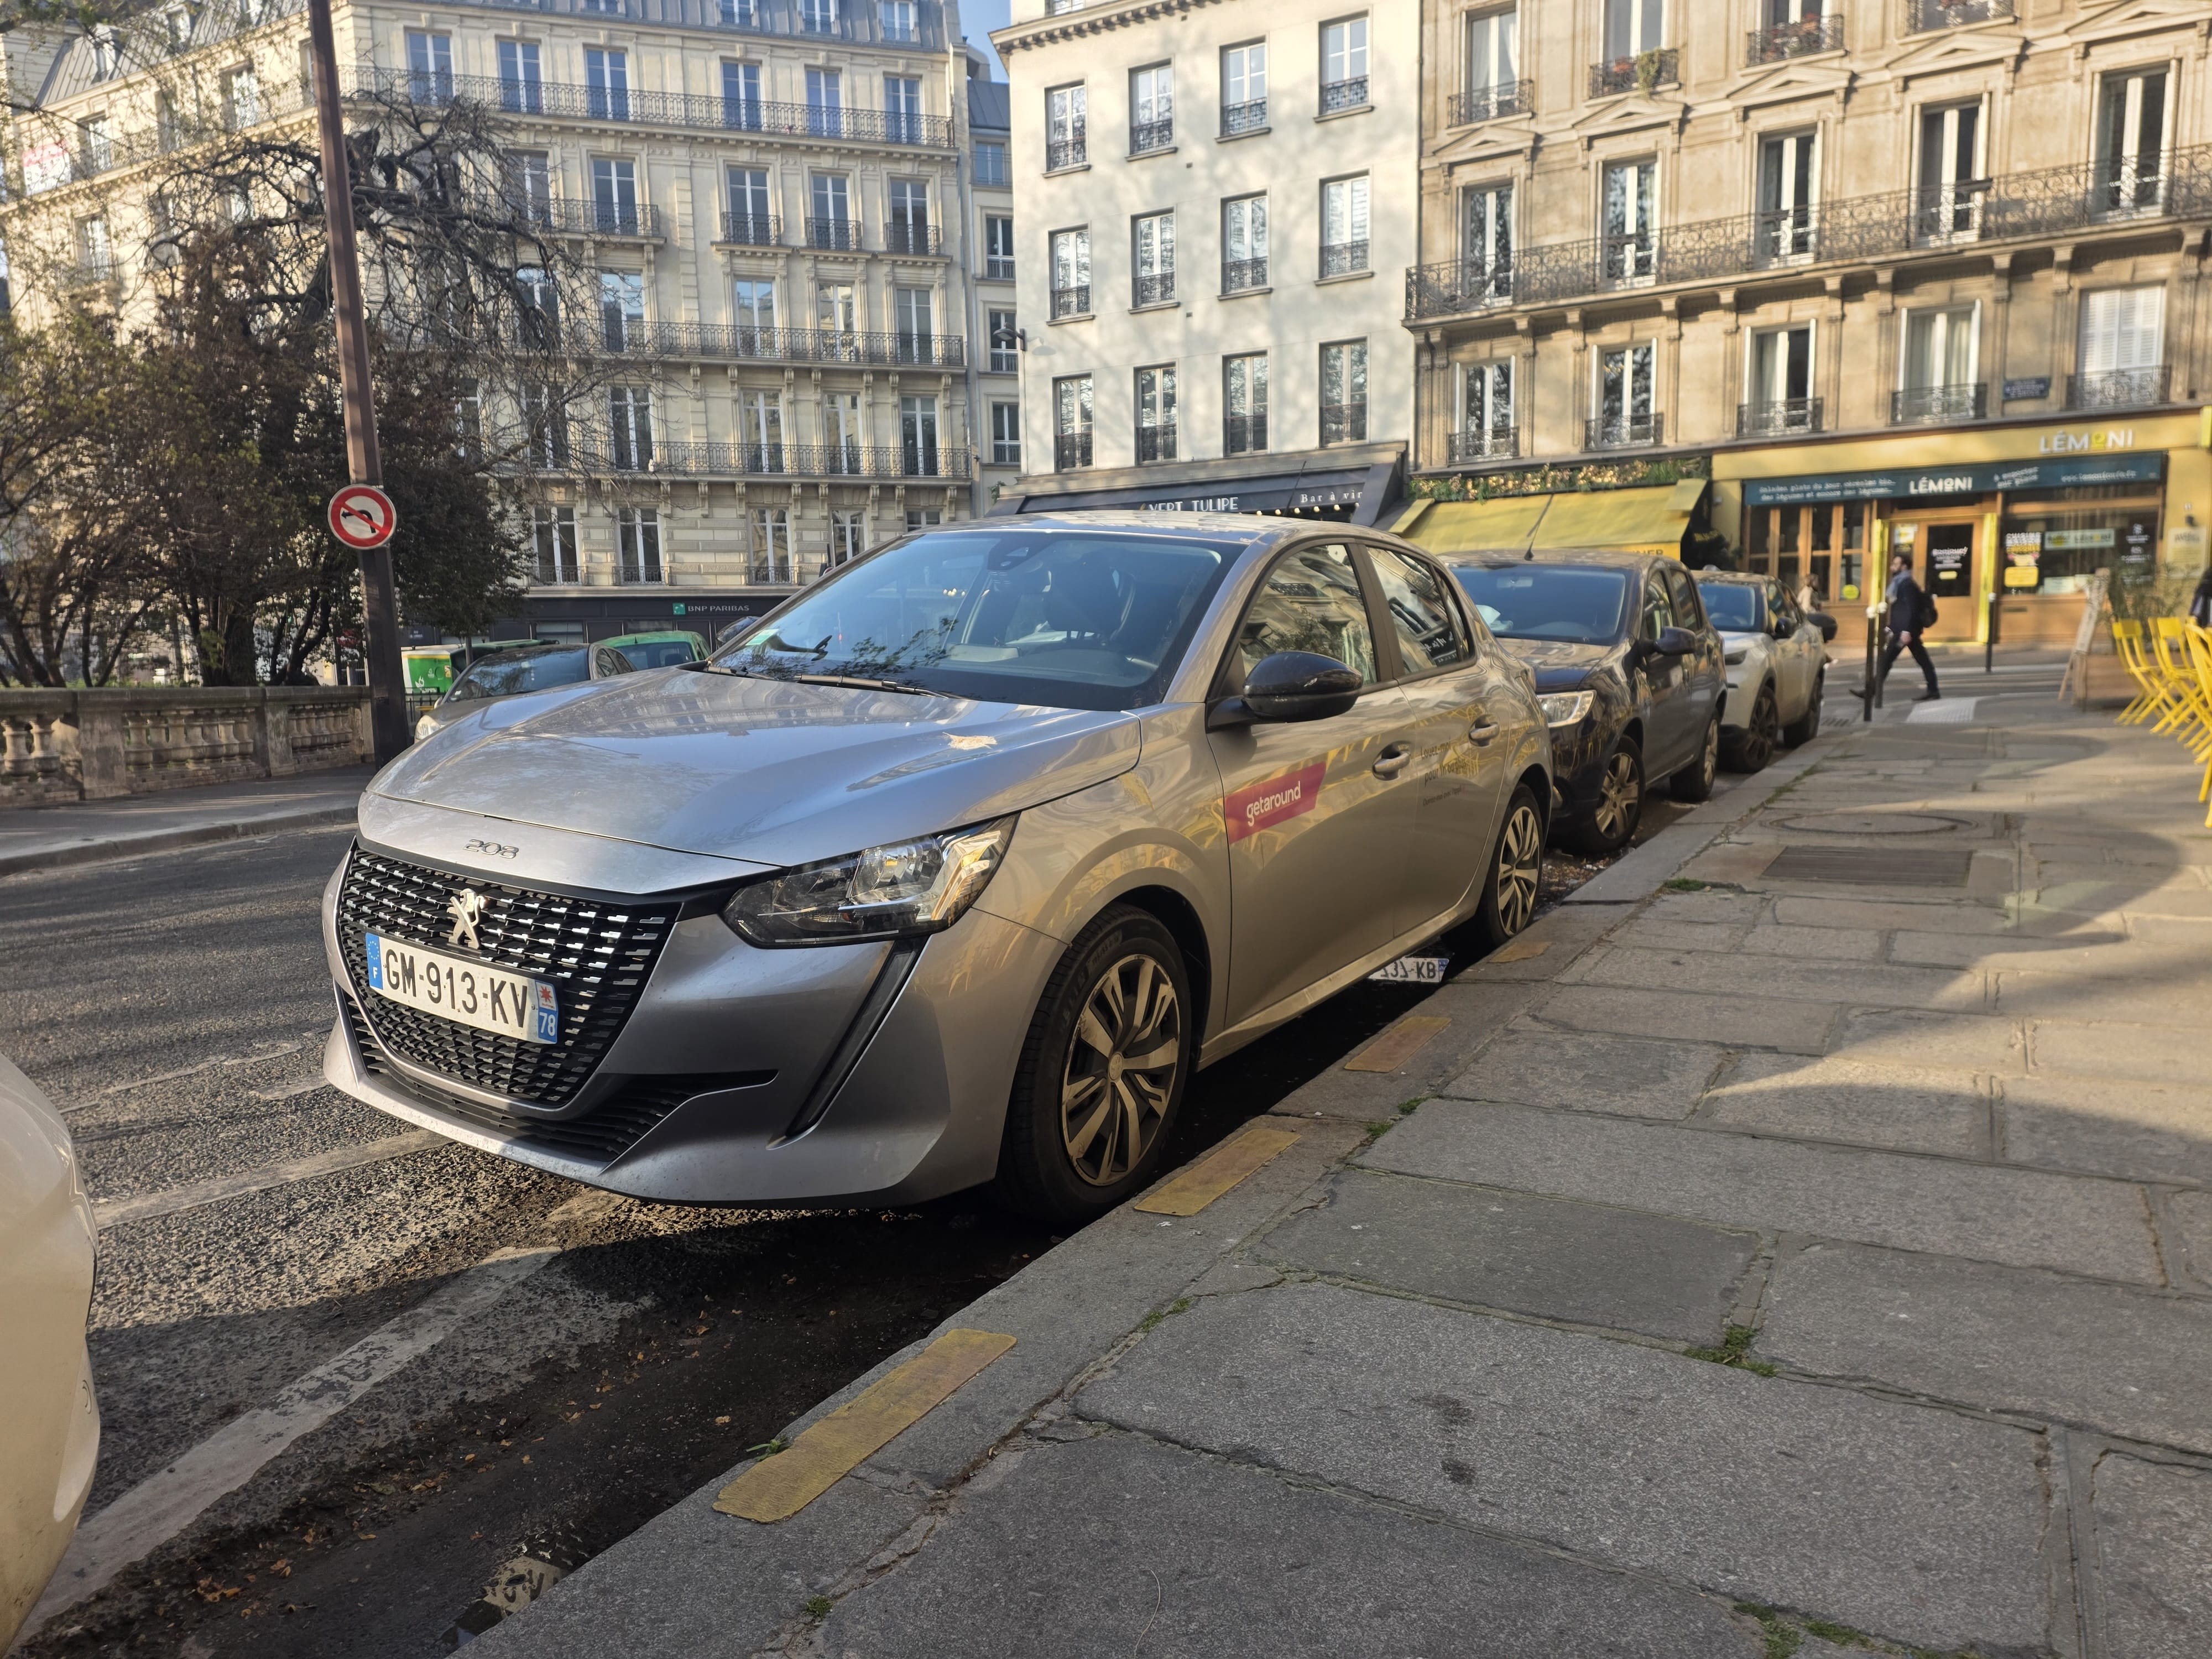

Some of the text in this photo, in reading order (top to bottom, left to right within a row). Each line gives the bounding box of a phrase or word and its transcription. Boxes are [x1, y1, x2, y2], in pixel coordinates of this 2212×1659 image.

[1910, 477, 1973, 494] LÉMONI
[1192, 497, 1239, 512] TULIPE
[1301, 494, 1322, 503] Bar
[1330, 491, 1335, 500] à
[1246, 780, 1301, 827] getaround
[463, 839, 519, 859] 208
[373, 967, 378, 978] F
[386, 949, 528, 1028] GM-913-KV
[540, 1011, 555, 1036] 78
